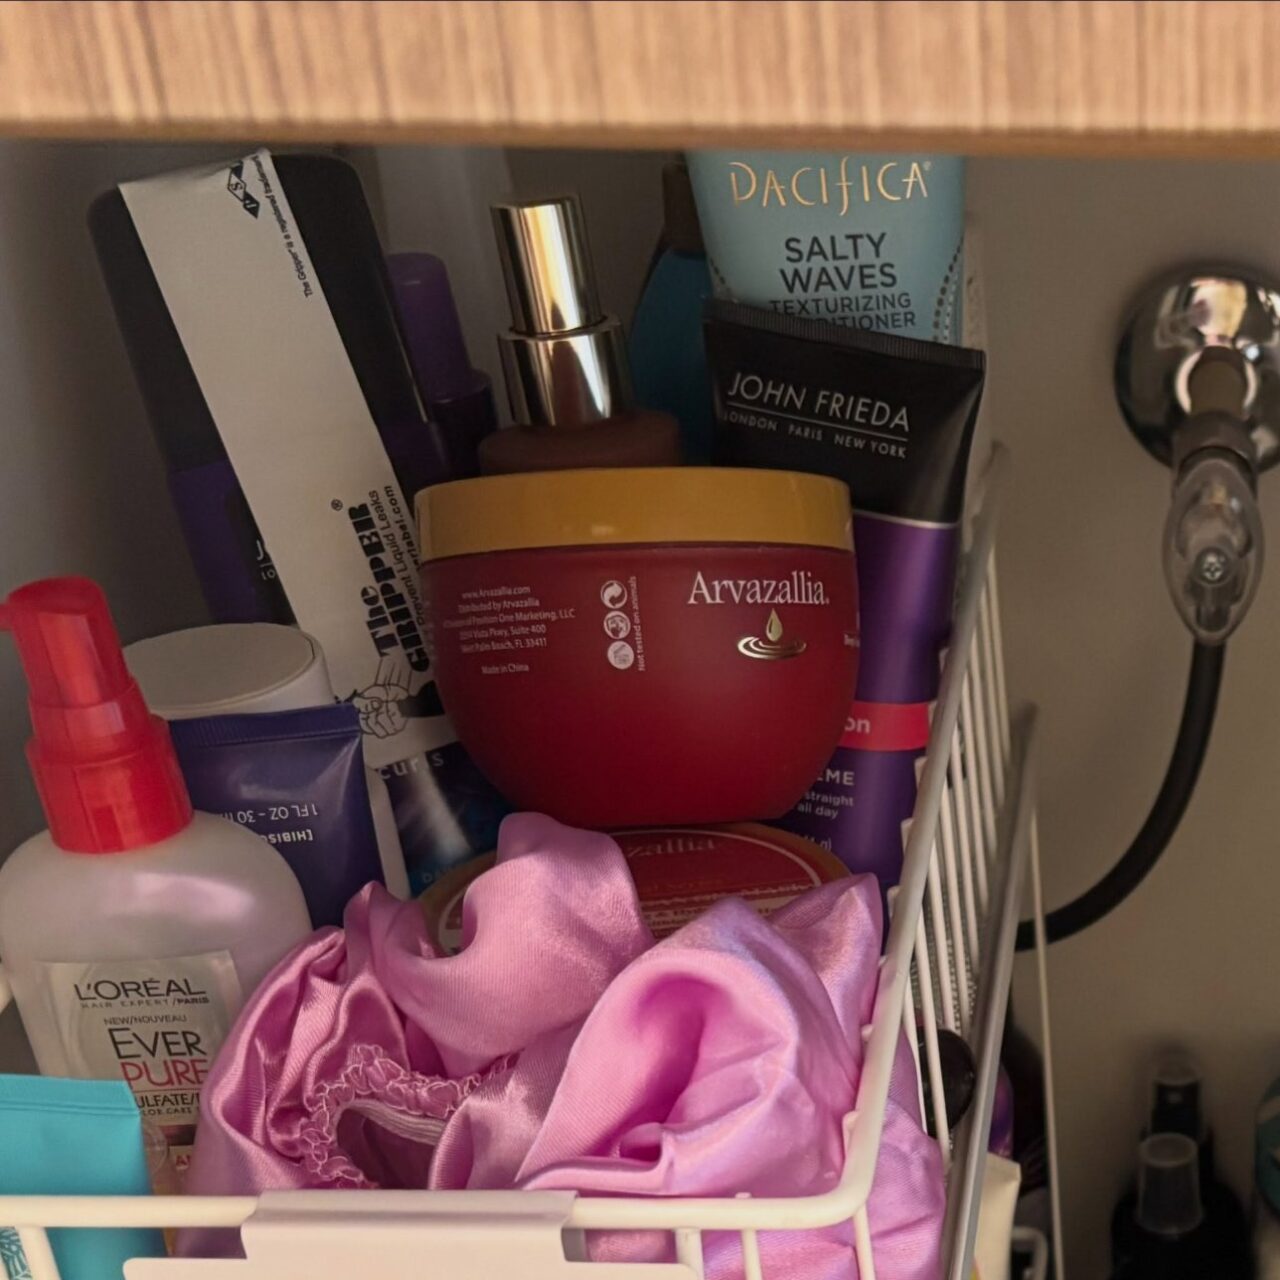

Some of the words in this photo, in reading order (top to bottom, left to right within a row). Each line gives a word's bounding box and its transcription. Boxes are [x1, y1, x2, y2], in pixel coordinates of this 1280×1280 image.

[784, 232, 887, 263] SALTY
[779, 263, 897, 294] WAVES
[769, 292, 912, 316] TEXTURIZING
[728, 371, 805, 410] JOHN
[814, 390, 911, 432] FRIEDA
[723, 411, 777, 431] LONDON
[788, 423, 823, 442] PARIS
[834, 434, 866, 450] NEW
[871, 438, 907, 458] YORK
[368, 489, 392, 531] Leaks
[382, 532, 408, 574] Liquid
[688, 571, 826, 604] Arvazallia
[361, 586, 400, 657] The
[559, 608, 576, 619] LLC
[634, 625, 643, 654] tested
[237, 810, 256, 824] 30
[268, 806, 290, 821] OZ
[291, 804, 310, 817] FL
[815, 804, 839, 820] day
[74, 977, 207, 1001] L'ORÉAL
